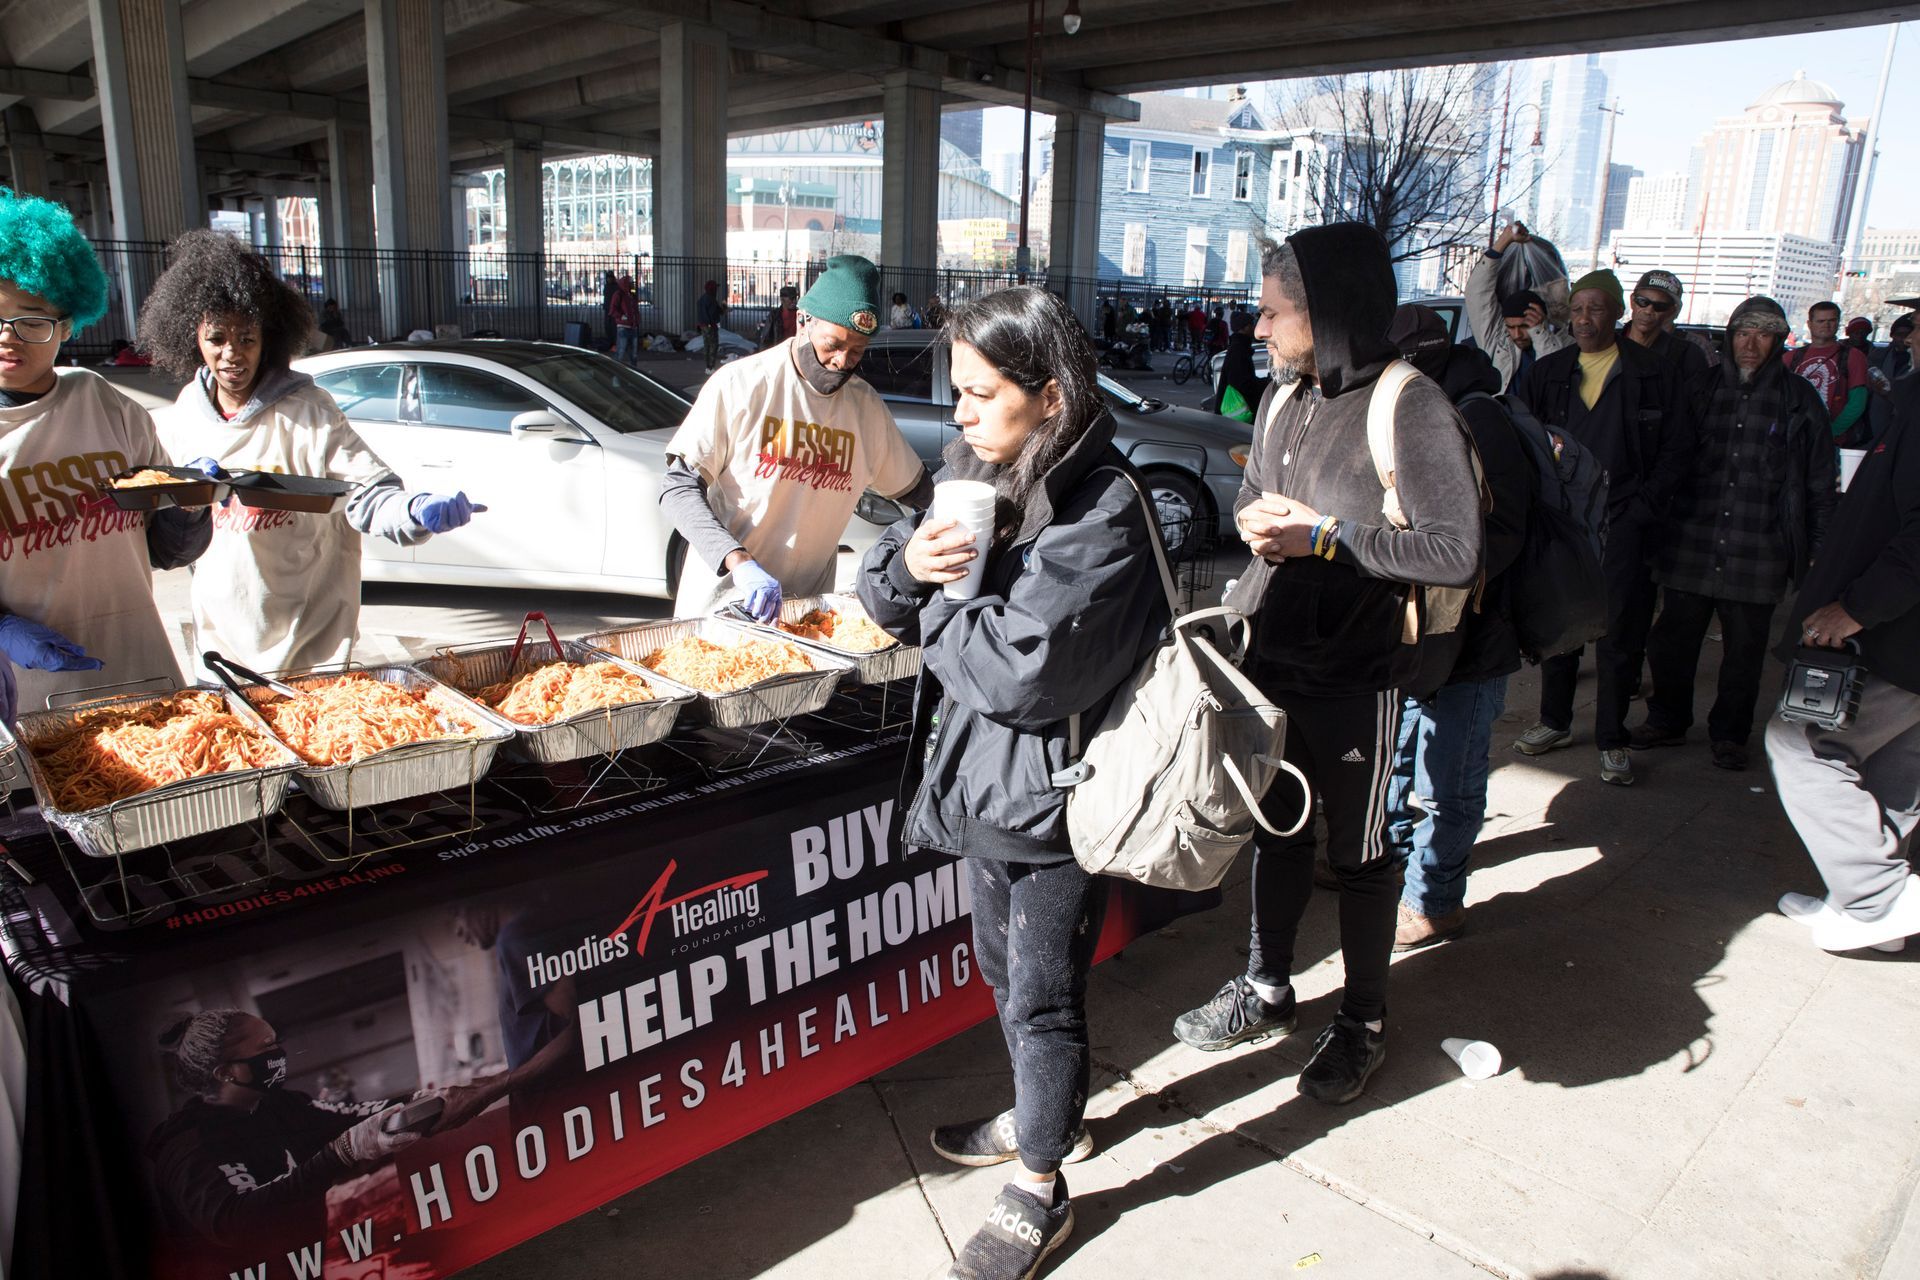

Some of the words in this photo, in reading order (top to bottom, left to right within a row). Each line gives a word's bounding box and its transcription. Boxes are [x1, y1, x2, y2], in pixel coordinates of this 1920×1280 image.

[832, 124, 875, 138] Minute
[760, 415, 856, 475] BLESSED
[0, 450, 129, 538] LESSED
[22, 515, 82, 559] the
[436, 842, 490, 861] SHOP
[790, 798, 895, 897] BUY
[165, 863, 407, 929] #HOODIES4HEALING
[526, 931, 630, 989] Hoodies
[671, 882, 761, 938] Healing
[671, 915, 767, 956] FOUNDATION
[577, 955, 728, 1072] HELP
[735, 909, 841, 1006] THE
[986, 1203, 1043, 1247] didas
